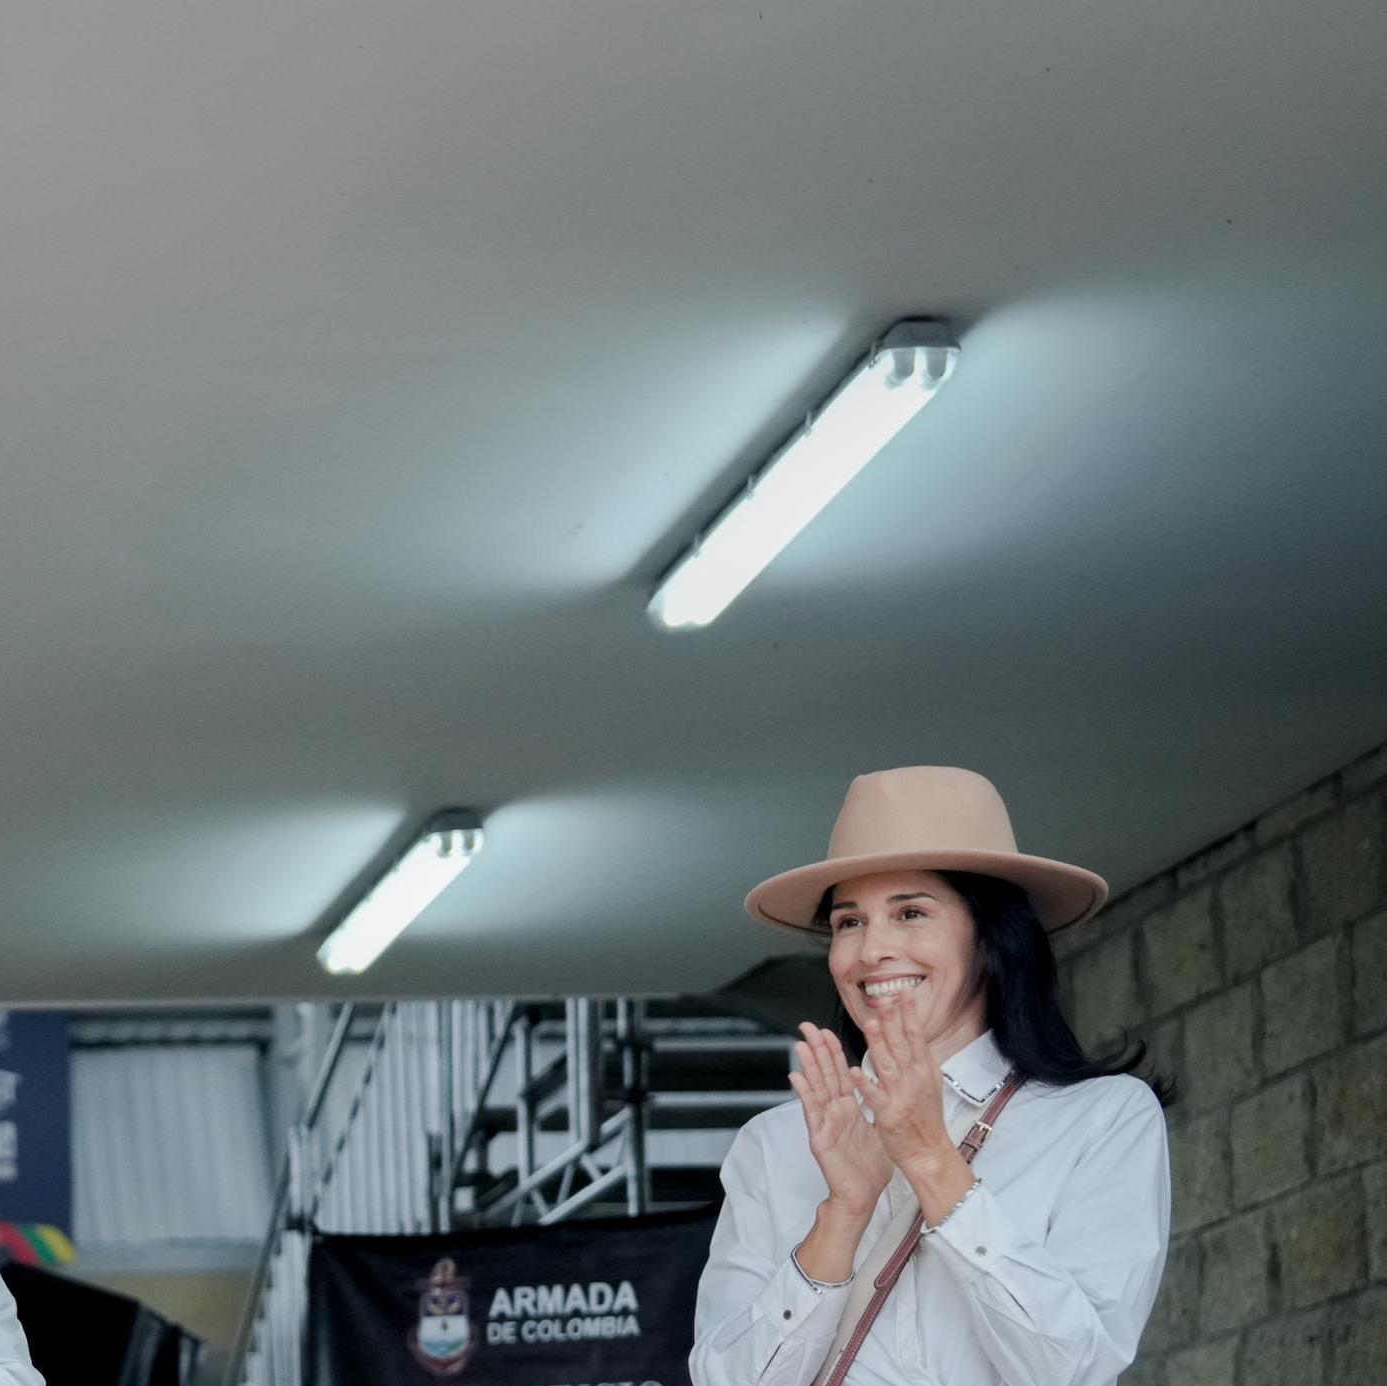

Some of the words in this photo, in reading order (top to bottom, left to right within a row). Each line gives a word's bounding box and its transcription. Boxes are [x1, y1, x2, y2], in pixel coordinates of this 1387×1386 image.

[488, 1280, 639, 1319] ARMADA
[487, 1323, 518, 1345] DE
[522, 1315, 641, 1342] COLOMBIA
